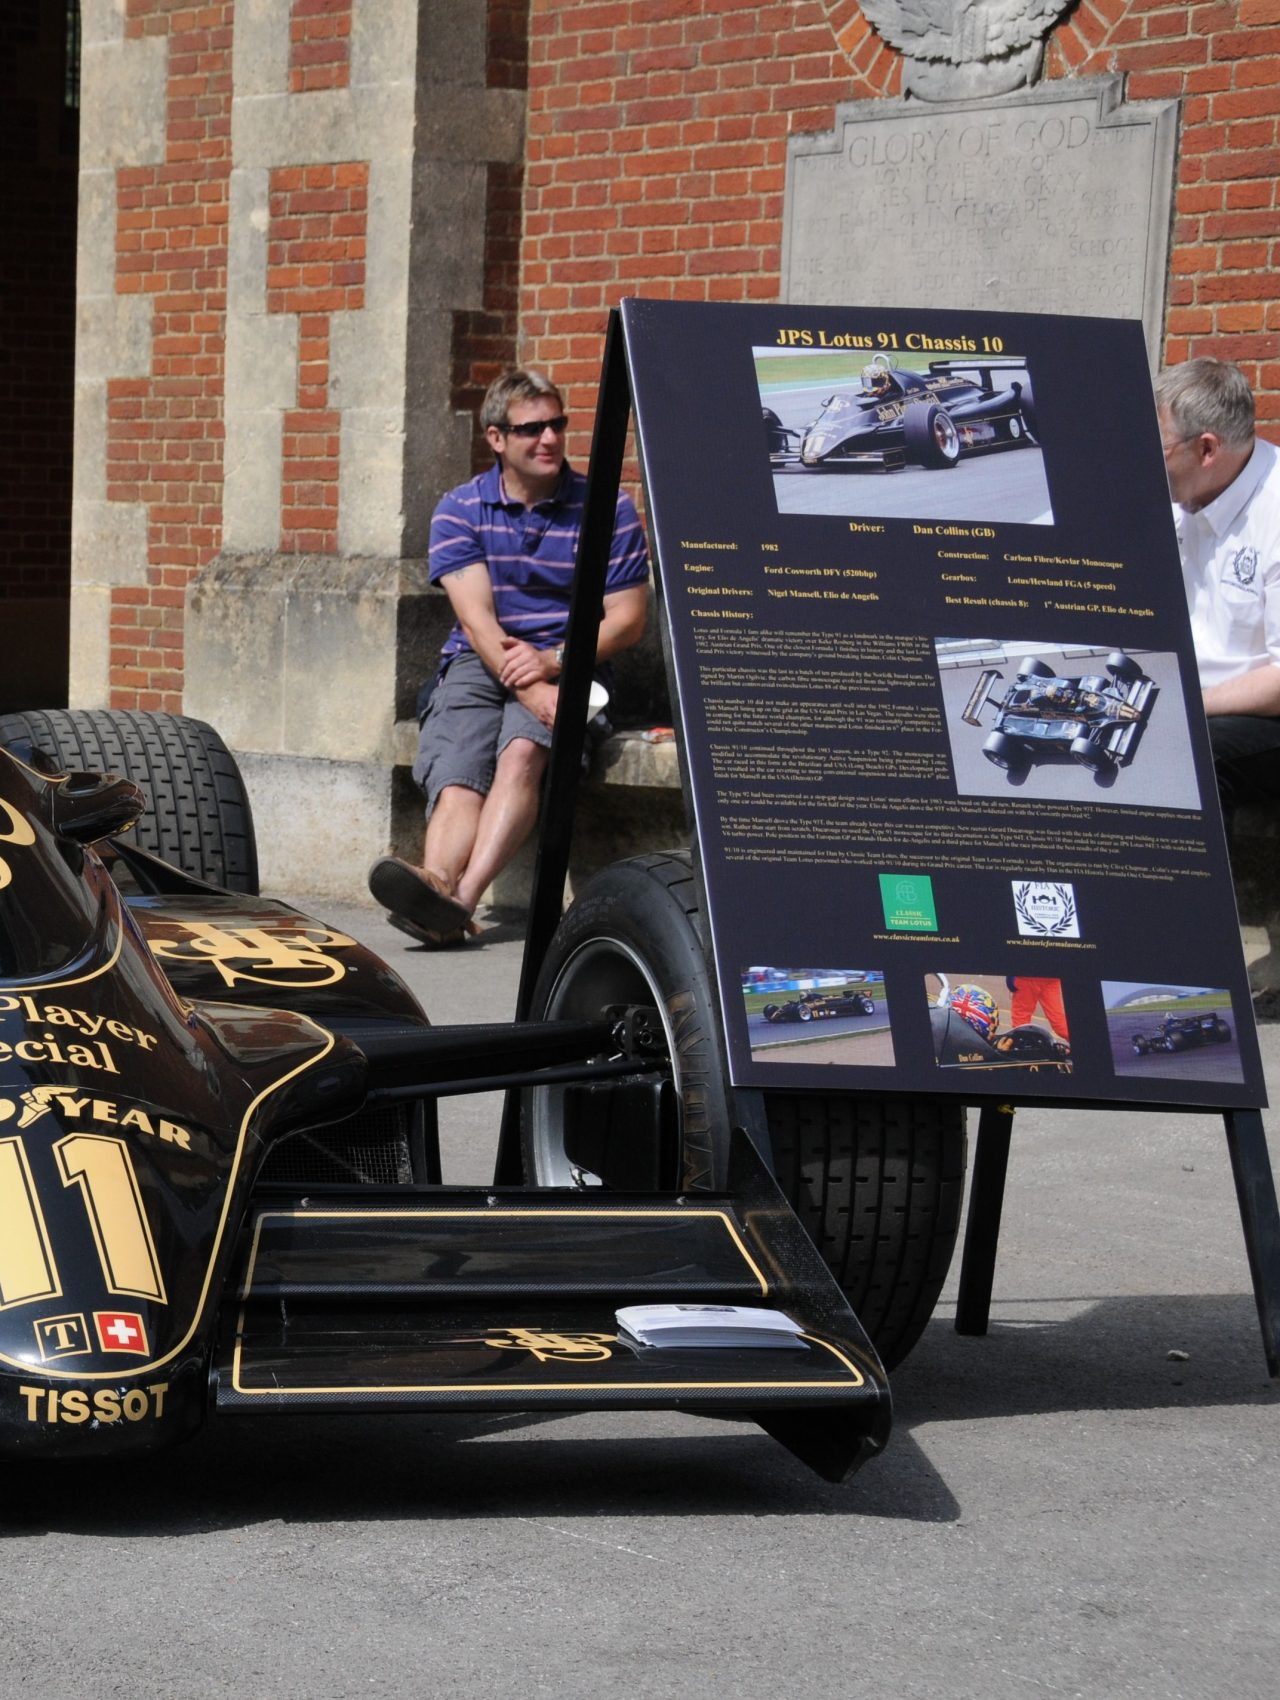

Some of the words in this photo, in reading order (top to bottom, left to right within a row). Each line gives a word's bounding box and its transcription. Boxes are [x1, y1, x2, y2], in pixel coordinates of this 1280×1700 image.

[849, 129, 950, 168] GLORY
[959, 123, 1003, 157] OF
[1014, 115, 1091, 152] GOD
[924, 181, 975, 204] LYLE
[776, 329, 813, 345] JPS
[818, 330, 873, 347] Lotus
[877, 332, 898, 348] 91
[905, 333, 976, 351] Chassis
[982, 336, 1003, 352] 10
[849, 522, 884, 532] Driver:
[913, 525, 933, 534] Dan
[935, 526, 969, 536] Collins
[971, 527, 995, 538] (GB)
[680, 541, 738, 549] Manufactured:
[761, 543, 778, 551] 1982
[937, 550, 989, 560] Construction:
[1003, 553, 1032, 562] Carbon
[684, 563, 714, 572] Engine:
[764, 566, 783, 574] Ford
[784, 567, 822, 575] Cosworth
[823, 568, 840, 576] DFY
[941, 573, 976, 582] Gearbox:
[1007, 576, 1063, 586] Lotus/Hewland
[1064, 579, 1083, 588] FGA
[687, 586, 720, 595] Original
[721, 587, 753, 595] Drivers:
[767, 589, 788, 598] Nigel
[840, 591, 850, 599] de
[851, 592, 879, 601] Angelis
[690, 609, 720, 617] Chassis
[721, 610, 753, 619] History:
[945, 596, 961, 604] Best
[963, 596, 987, 605] Result
[988, 598, 1017, 606] (chassis
[1054, 602, 1086, 611] Austrian
[1101, 605, 1117, 613] Elio
[1117, 606, 1127, 614] de
[1128, 608, 1154, 616] Angelis
[44, 1321, 79, 1351] T
[19, 1383, 170, 1425] TISSOT
